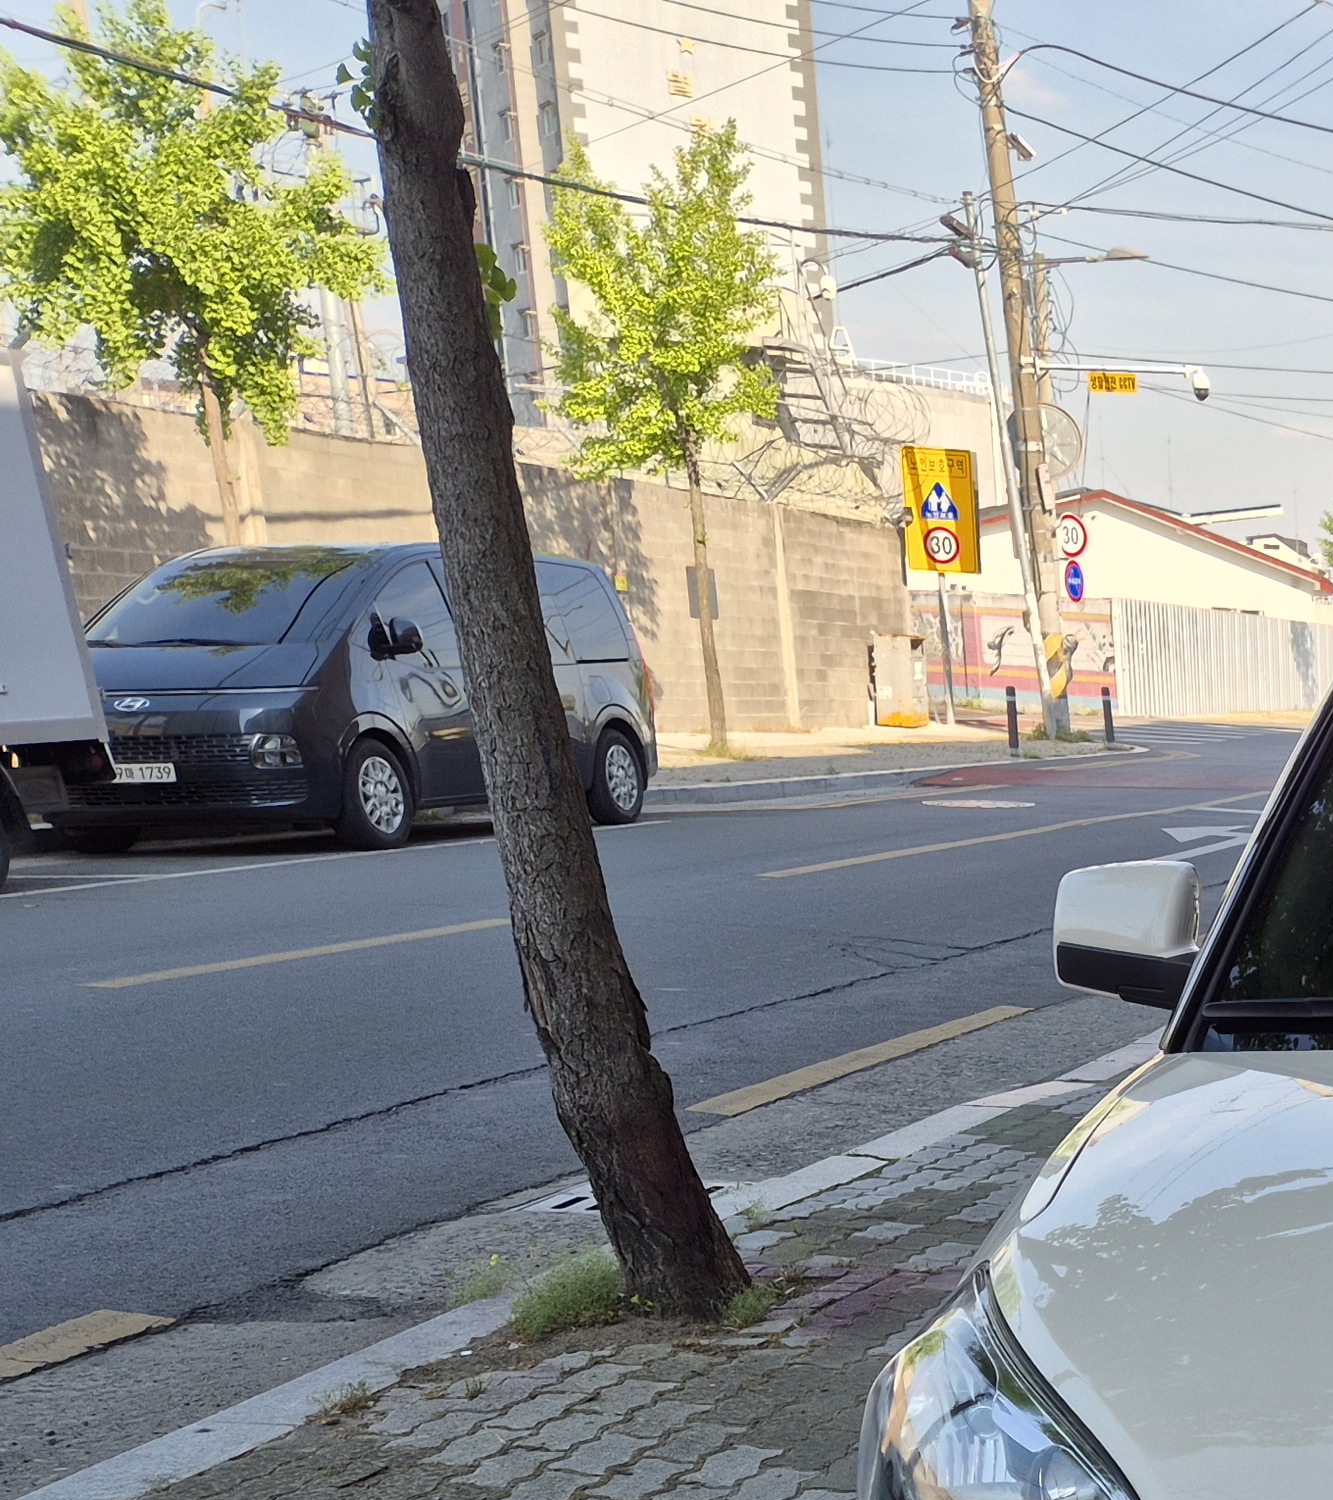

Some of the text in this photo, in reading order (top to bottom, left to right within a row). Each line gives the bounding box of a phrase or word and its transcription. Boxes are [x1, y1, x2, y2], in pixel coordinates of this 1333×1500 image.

[908, 458, 964, 475] 노인보호구역
[1062, 526, 1078, 545] 30
[930, 535, 953, 555] 30
[139, 766, 171, 780] 1739
